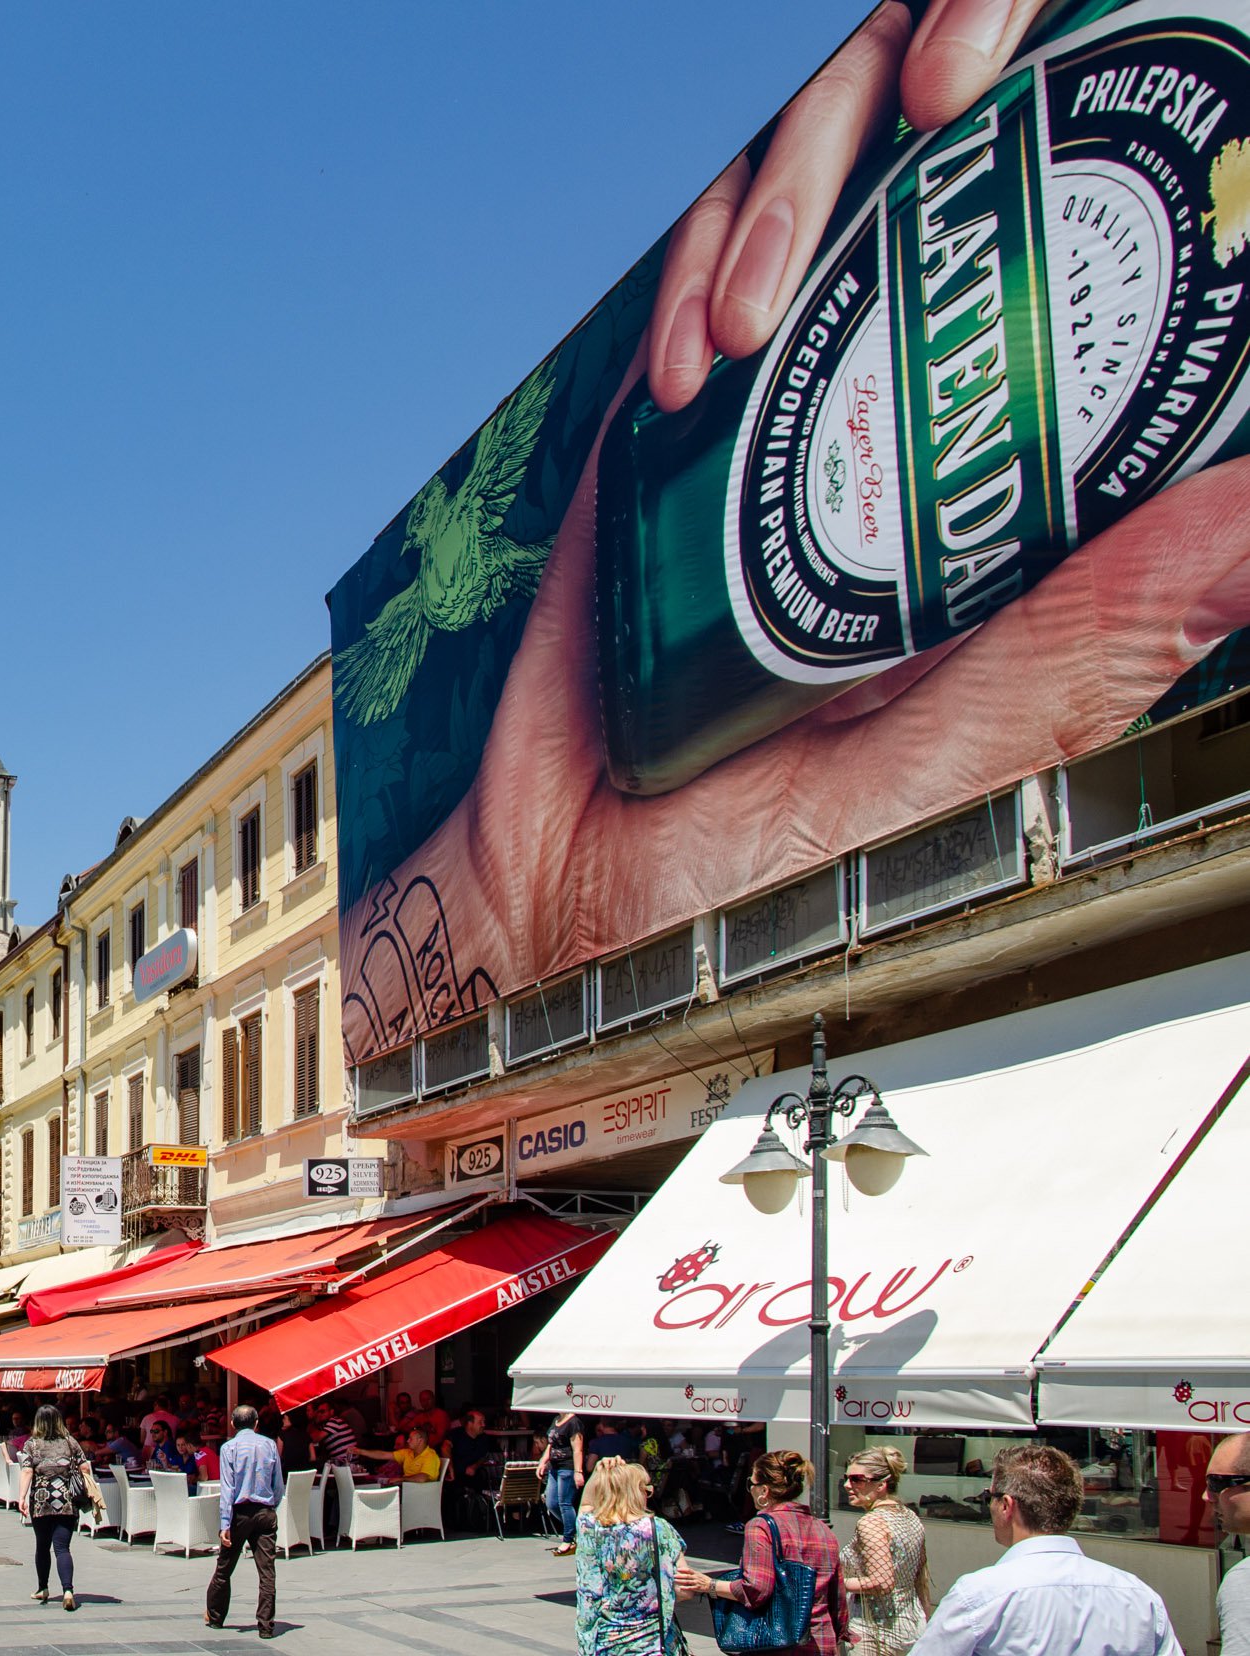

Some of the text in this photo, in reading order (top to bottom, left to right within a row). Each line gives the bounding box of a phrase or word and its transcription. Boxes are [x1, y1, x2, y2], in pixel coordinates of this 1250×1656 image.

[1070, 66, 1229, 154] PRILEPSKA
[1125, 140, 1193, 390] PRODUCT OF MACEDONIA
[1062, 194, 1142, 424] QUALITY SINCE
[1097, 282, 1244, 498] PIVARNICA
[759, 271, 880, 644] MACEDONIAN PREMIUM BEER
[846, 374, 884, 545] Lager Beer
[793, 377, 840, 587] BREWED WITH NATURAL INGREDIENTS
[603, 1087, 672, 1134] ESPRIT
[160, 1151, 200, 1162] DHL
[518, 1120, 587, 1161] CASIO
[616, 1127, 658, 1146] timewear
[315, 1167, 342, 1181] 925
[468, 1147, 491, 1171] 925
[497, 1258, 577, 1309] AMSTEL
[1, 1370, 25, 1389] AMSTEL
[54, 1369, 87, 1389] AMSTEL
[334, 1331, 418, 1386] AMSTEL
[571, 1393, 614, 1409] arow
[690, 1396, 745, 1414] arow
[843, 1399, 913, 1419] arow
